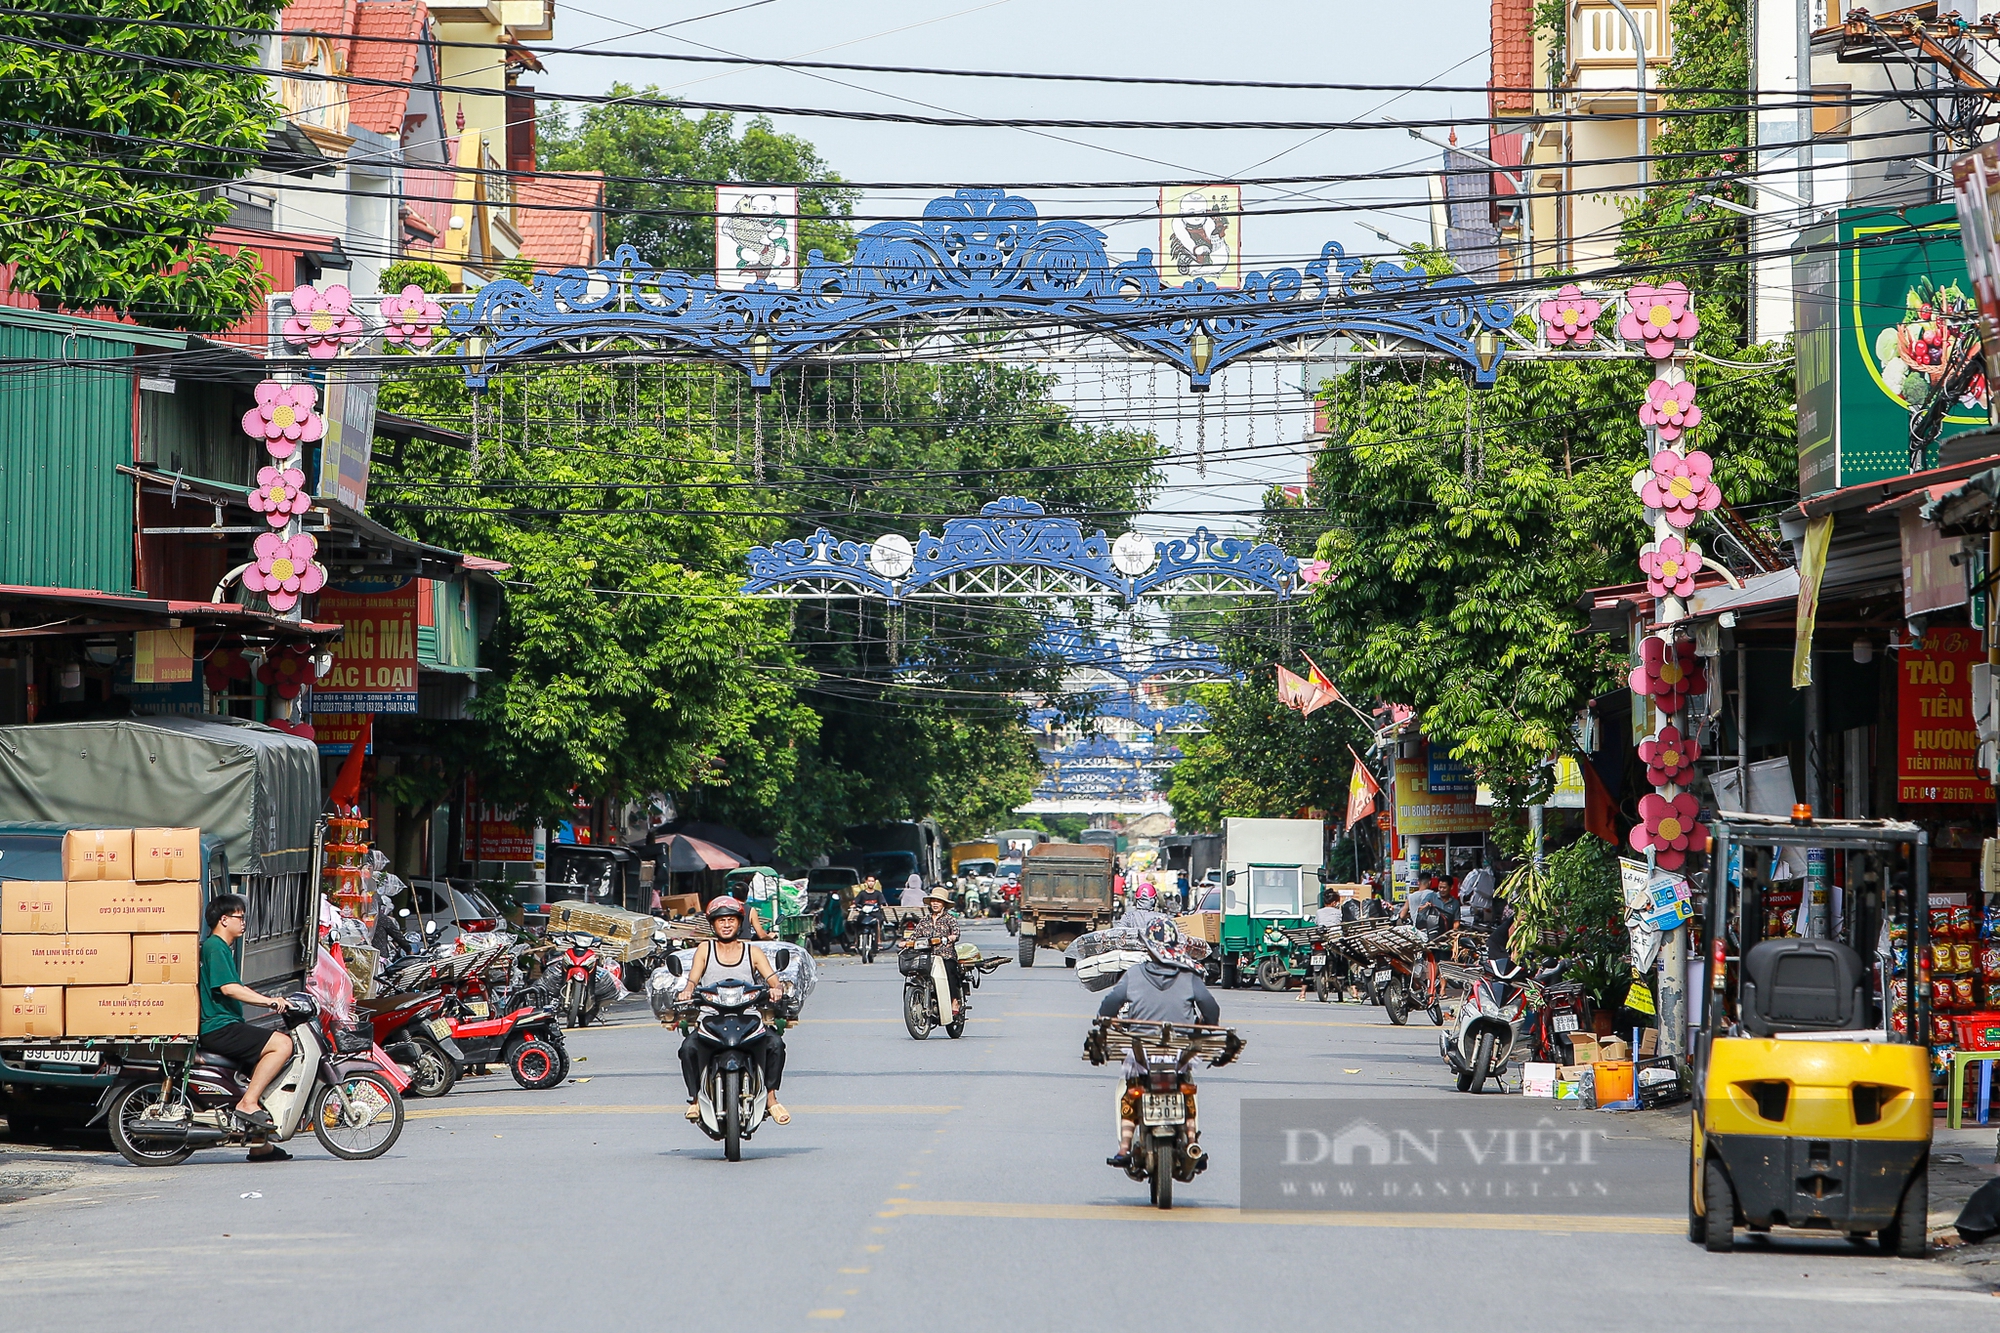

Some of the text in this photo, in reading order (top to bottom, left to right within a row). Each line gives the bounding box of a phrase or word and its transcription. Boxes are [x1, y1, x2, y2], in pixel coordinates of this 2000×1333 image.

[320, 611, 414, 659] ÀNG MÃ
[1905, 654, 1955, 685] TÀO
[317, 663, 413, 691] CÁC LOẠI
[1919, 687, 1964, 718] TIỀN
[1913, 729, 1981, 750] HƯƠNG
[1906, 751, 1931, 770] TIỀN
[1903, 786, 1918, 799] ĐT:
[1928, 896, 1951, 906] RION
[99, 906, 112, 914] CAO
[122, 906, 136, 914] VIỆT
[136, 906, 151, 914] LINH
[152, 906, 165, 914] TÂM
[61, 949, 75, 957] VIỆT
[98, 999, 112, 1007] TÂM
[127, 1000, 141, 1008] VIỆT
[1149, 1107, 1178, 1119] 7301
